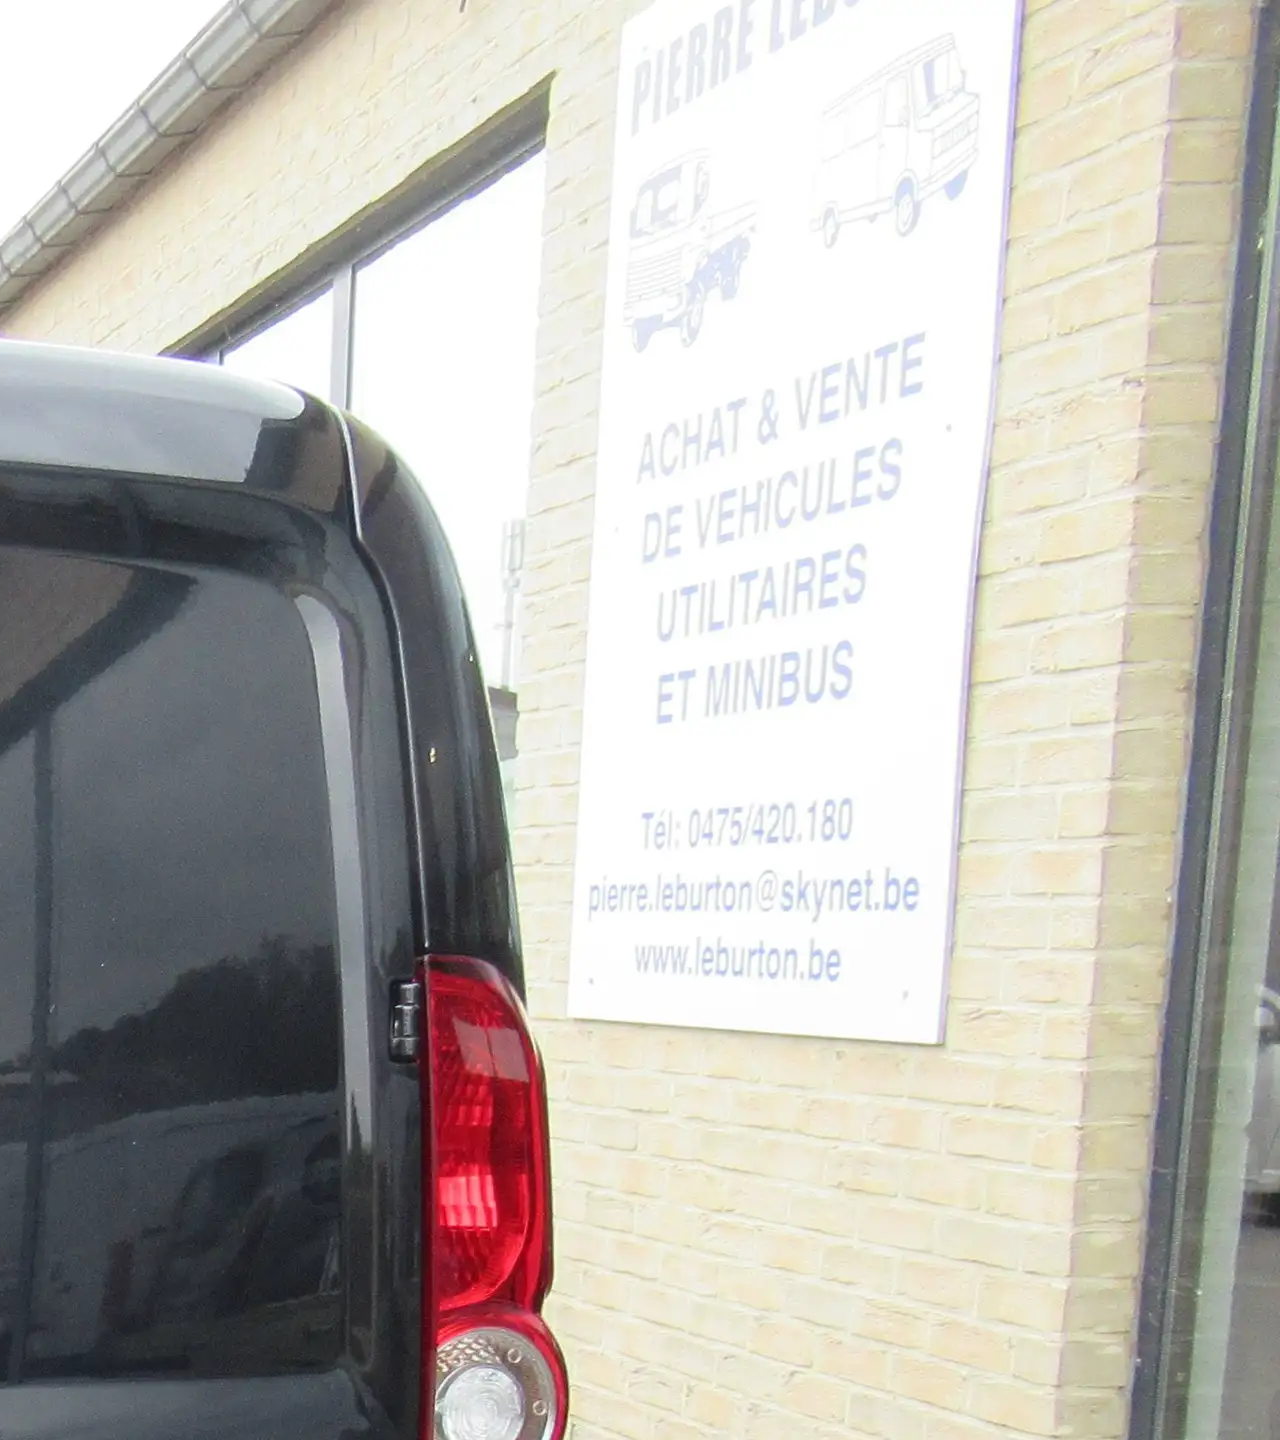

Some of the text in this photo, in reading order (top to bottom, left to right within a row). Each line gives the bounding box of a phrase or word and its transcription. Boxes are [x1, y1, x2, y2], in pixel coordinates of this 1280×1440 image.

[637, 332, 926, 484] ACHAT & VENTE
[642, 438, 904, 564] DE VEHICULES
[656, 543, 868, 642] UTILITAIRES
[656, 640, 855, 725] ET MINIBUS
[641, 797, 854, 850] Tél: 0475/420.180
[588, 867, 921, 923] pierre.leburton@skynet.be
[634, 936, 843, 983] www.leburton.be
